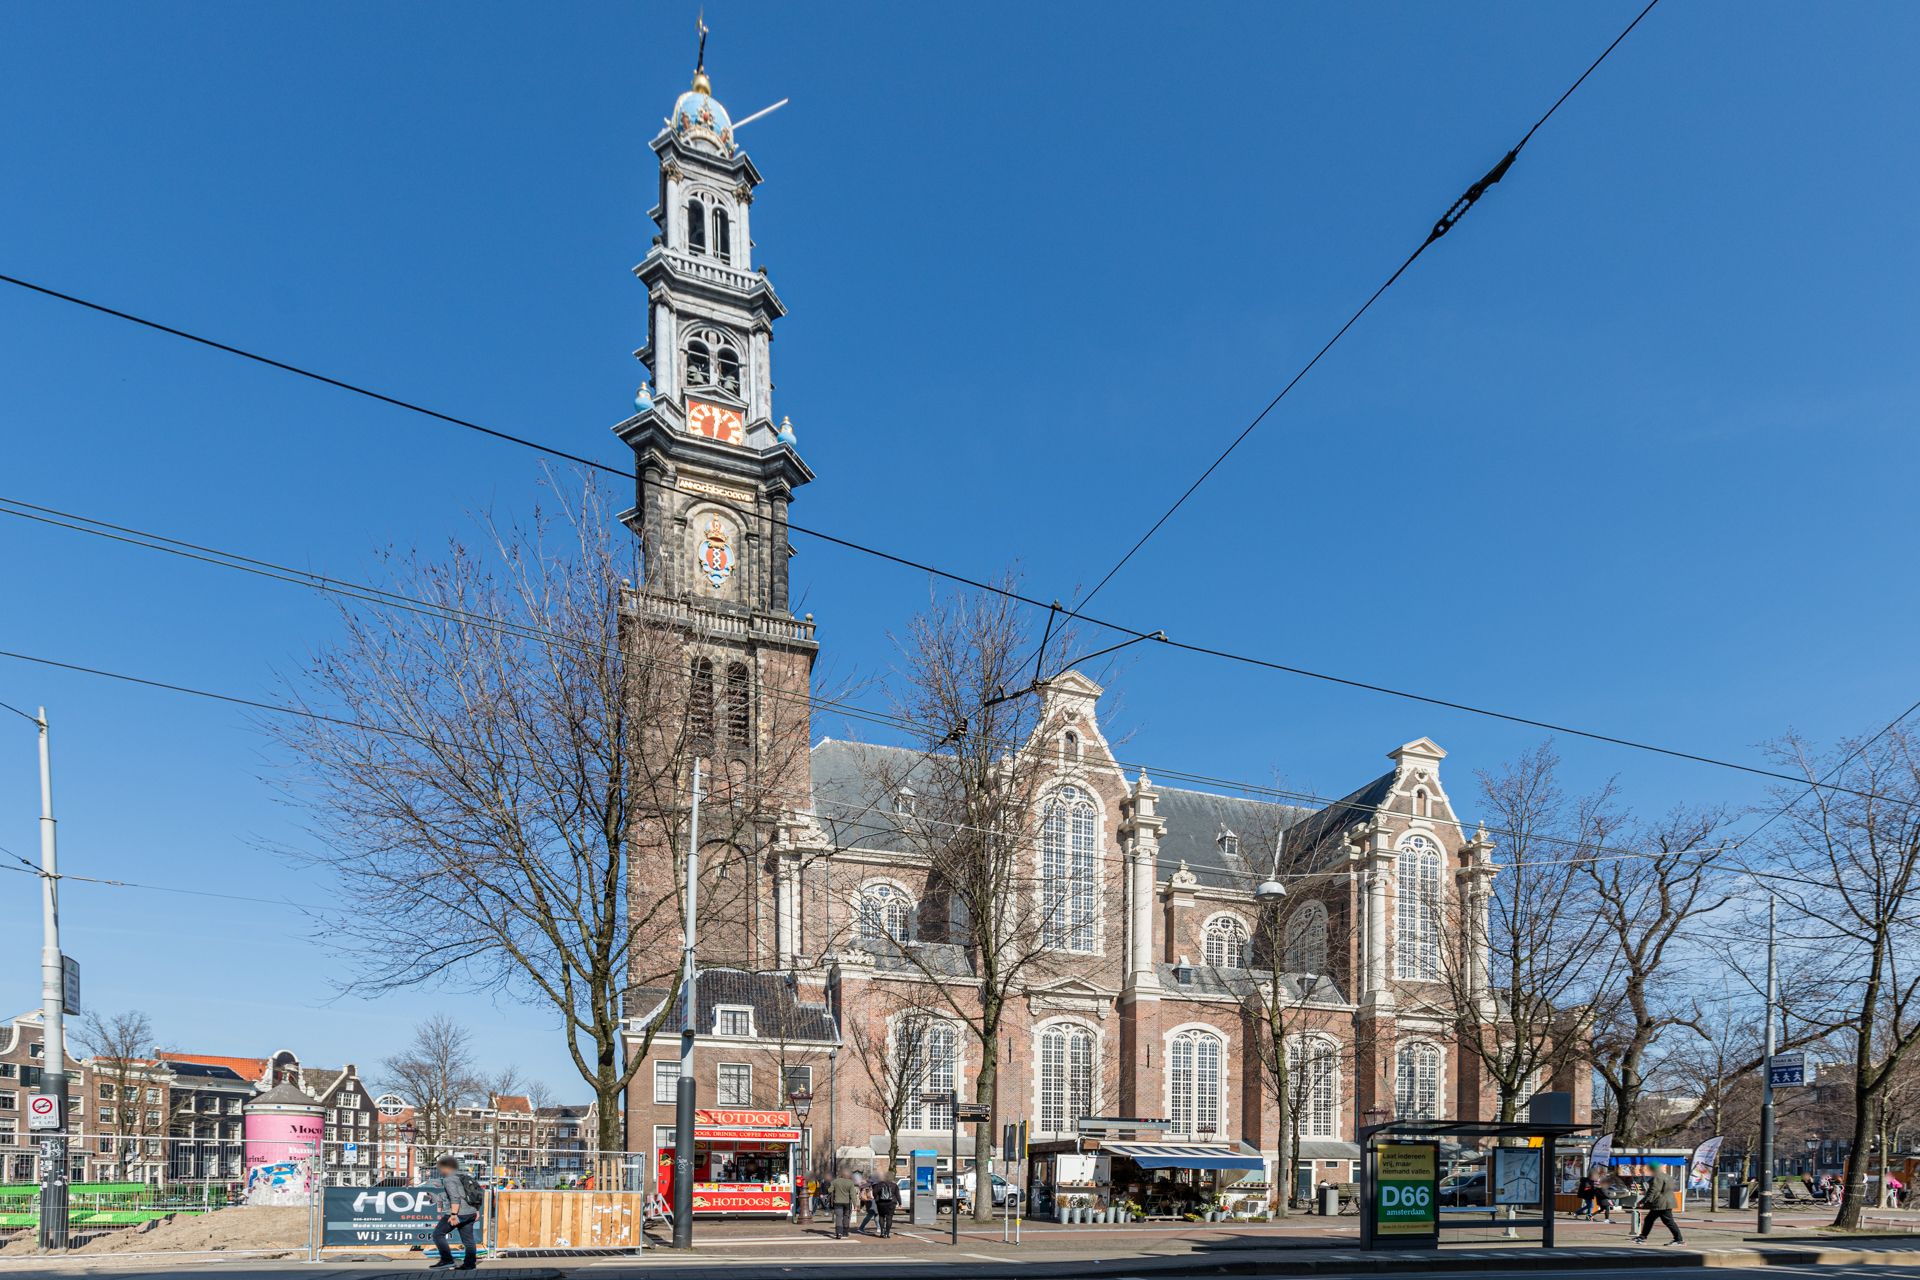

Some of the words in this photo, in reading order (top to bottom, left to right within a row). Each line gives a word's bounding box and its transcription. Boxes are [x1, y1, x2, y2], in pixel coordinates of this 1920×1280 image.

[711, 1112, 785, 1125] HOTDOGS
[290, 1125, 322, 1134] Moco
[1397, 1152, 1426, 1160] iedereen
[1382, 1186, 1430, 1206] D66
[353, 1191, 442, 1214] HOP
[712, 1197, 770, 1207] HOTDOGS
[1386, 1208, 1426, 1216] amsterdam
[356, 1231, 380, 1242] Wij
[385, 1231, 413, 1242] zijn
[418, 1232, 453, 1241] opn
